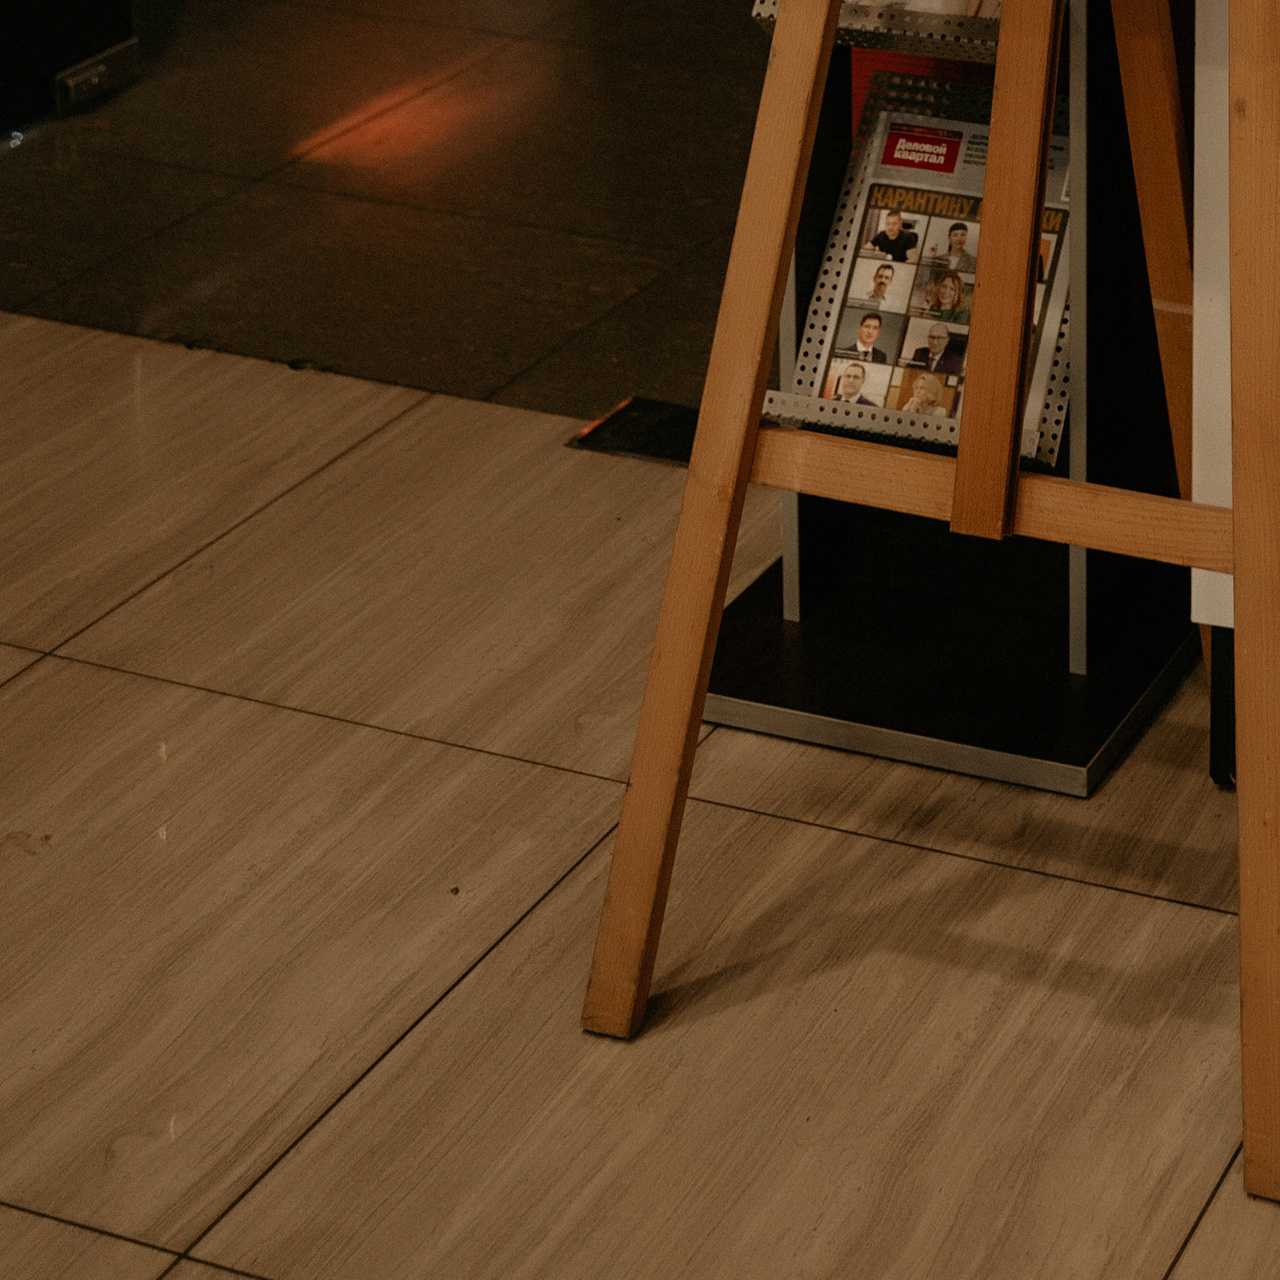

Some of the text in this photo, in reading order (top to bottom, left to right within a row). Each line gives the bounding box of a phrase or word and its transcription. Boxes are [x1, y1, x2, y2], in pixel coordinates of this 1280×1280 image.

[896, 138, 947, 155] Деловой
[893, 150, 945, 165] квартал
[870, 185, 973, 218] КАРАНТИНУ
